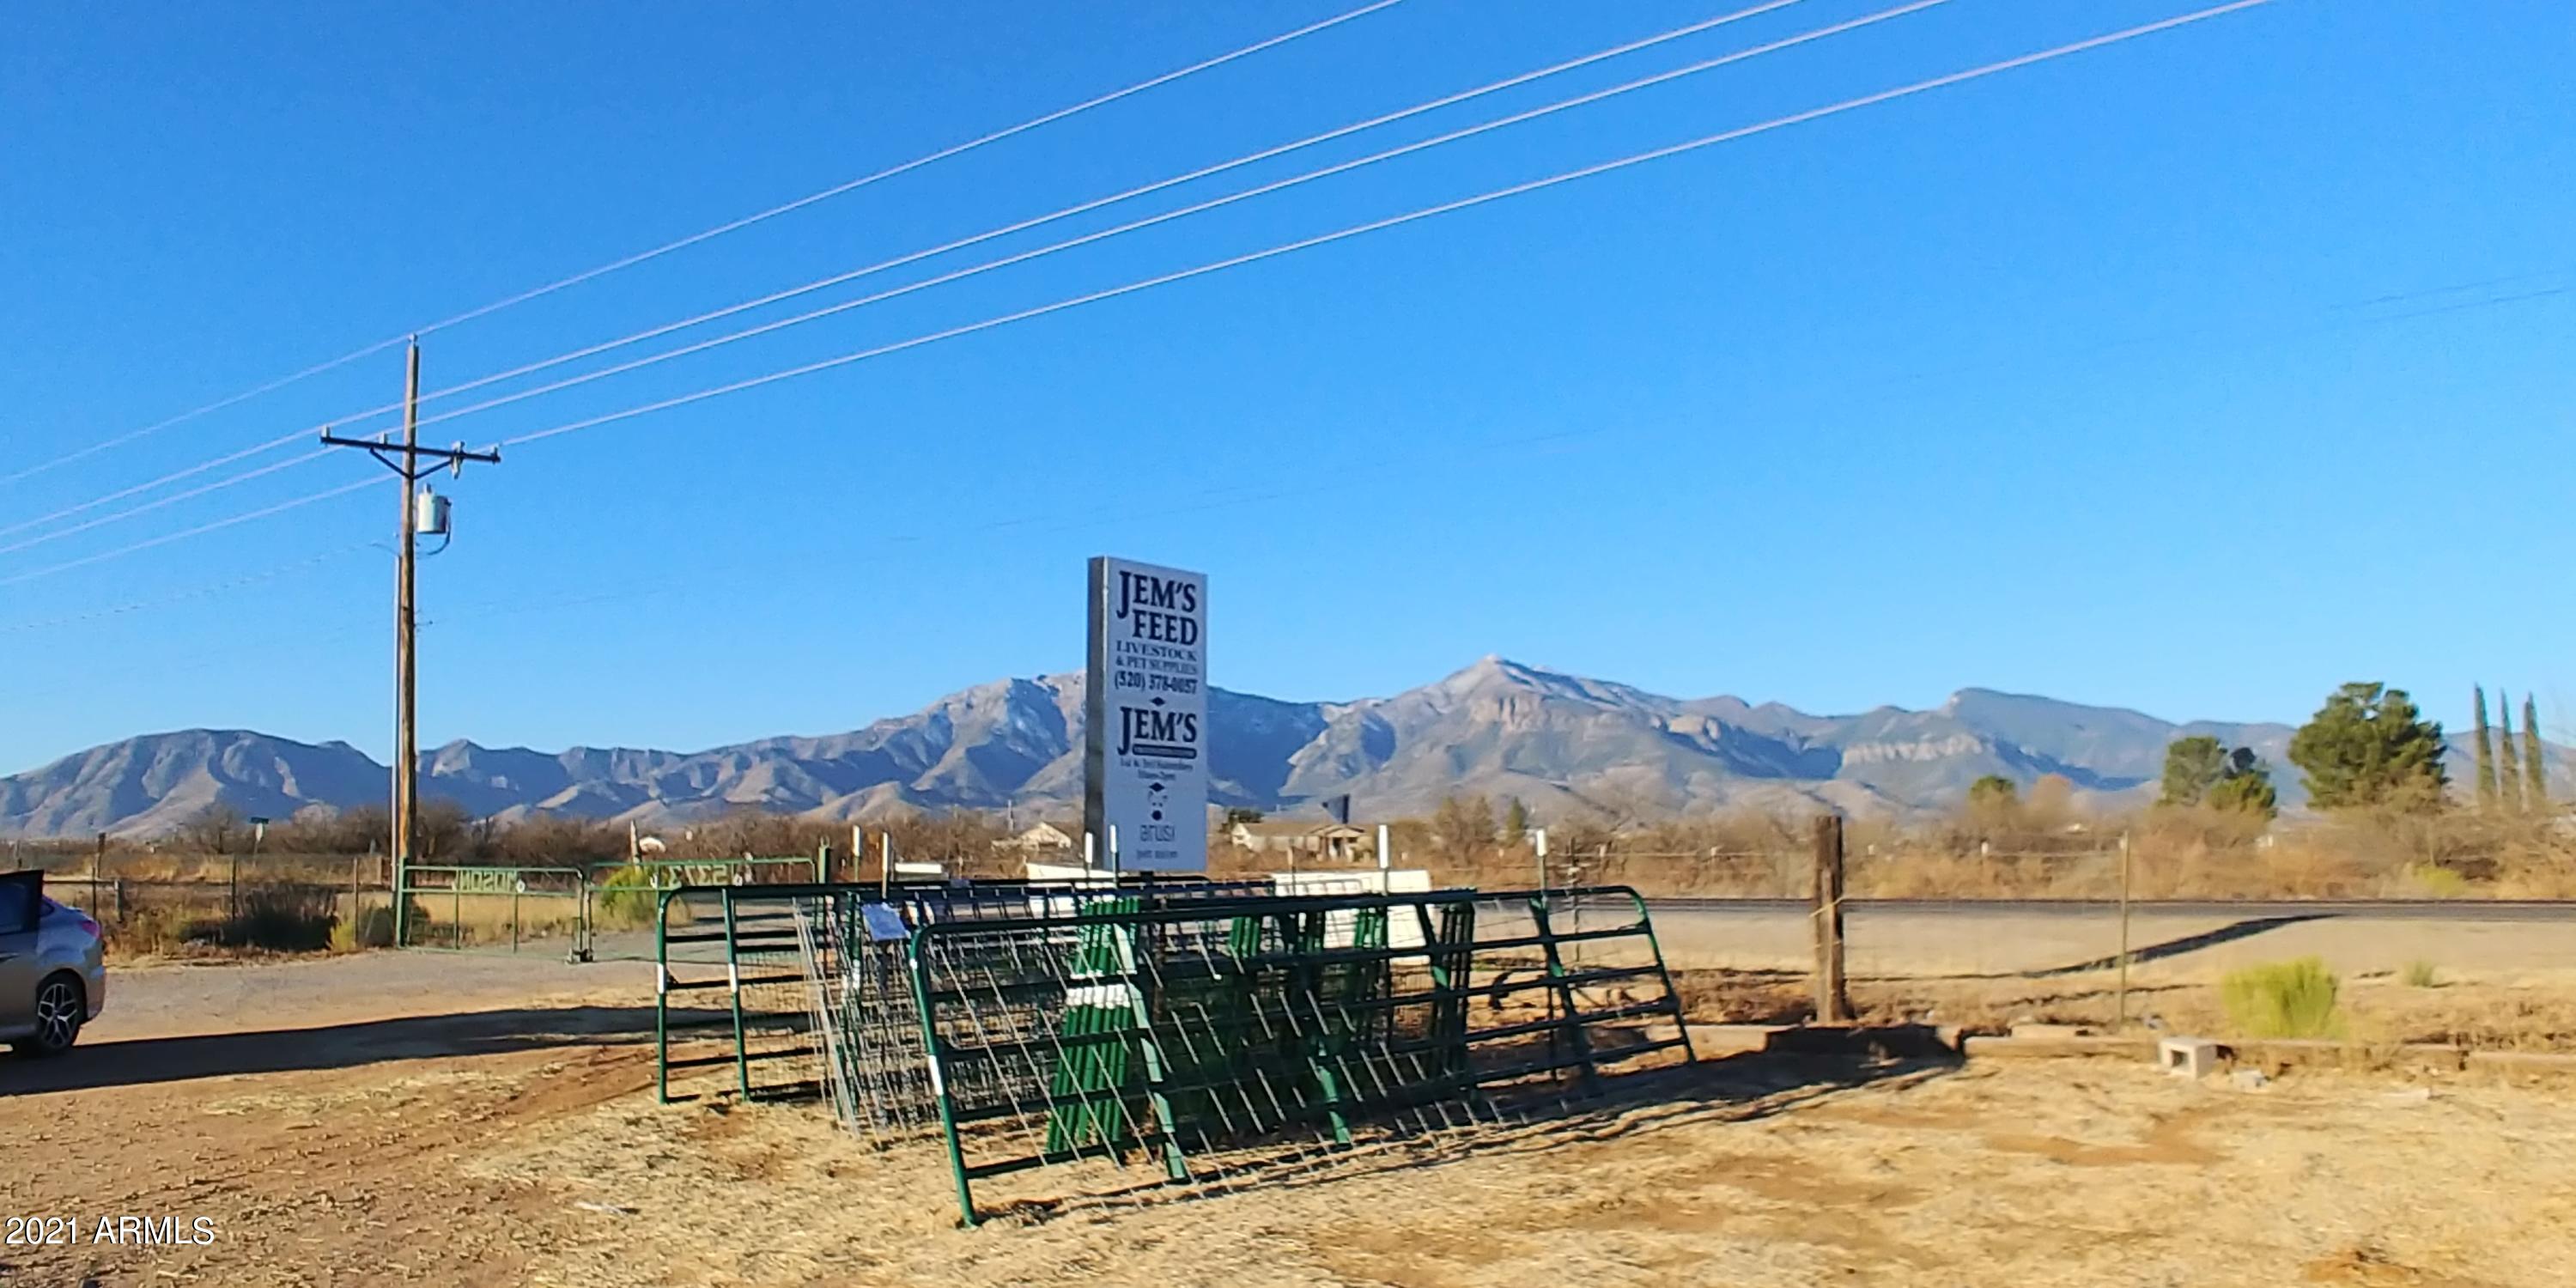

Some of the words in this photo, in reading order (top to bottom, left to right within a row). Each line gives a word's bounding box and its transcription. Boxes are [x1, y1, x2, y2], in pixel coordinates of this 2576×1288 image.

[1116, 570, 1196, 619] JEM'S
[1132, 609, 1198, 645] FEED
[1115, 655, 1124, 666] &
[1127, 656, 1146, 669] PET
[1116, 640, 1197, 661] LIVESTOCK
[1115, 670, 1146, 692] (520)
[1117, 706, 1197, 756] JEM'S
